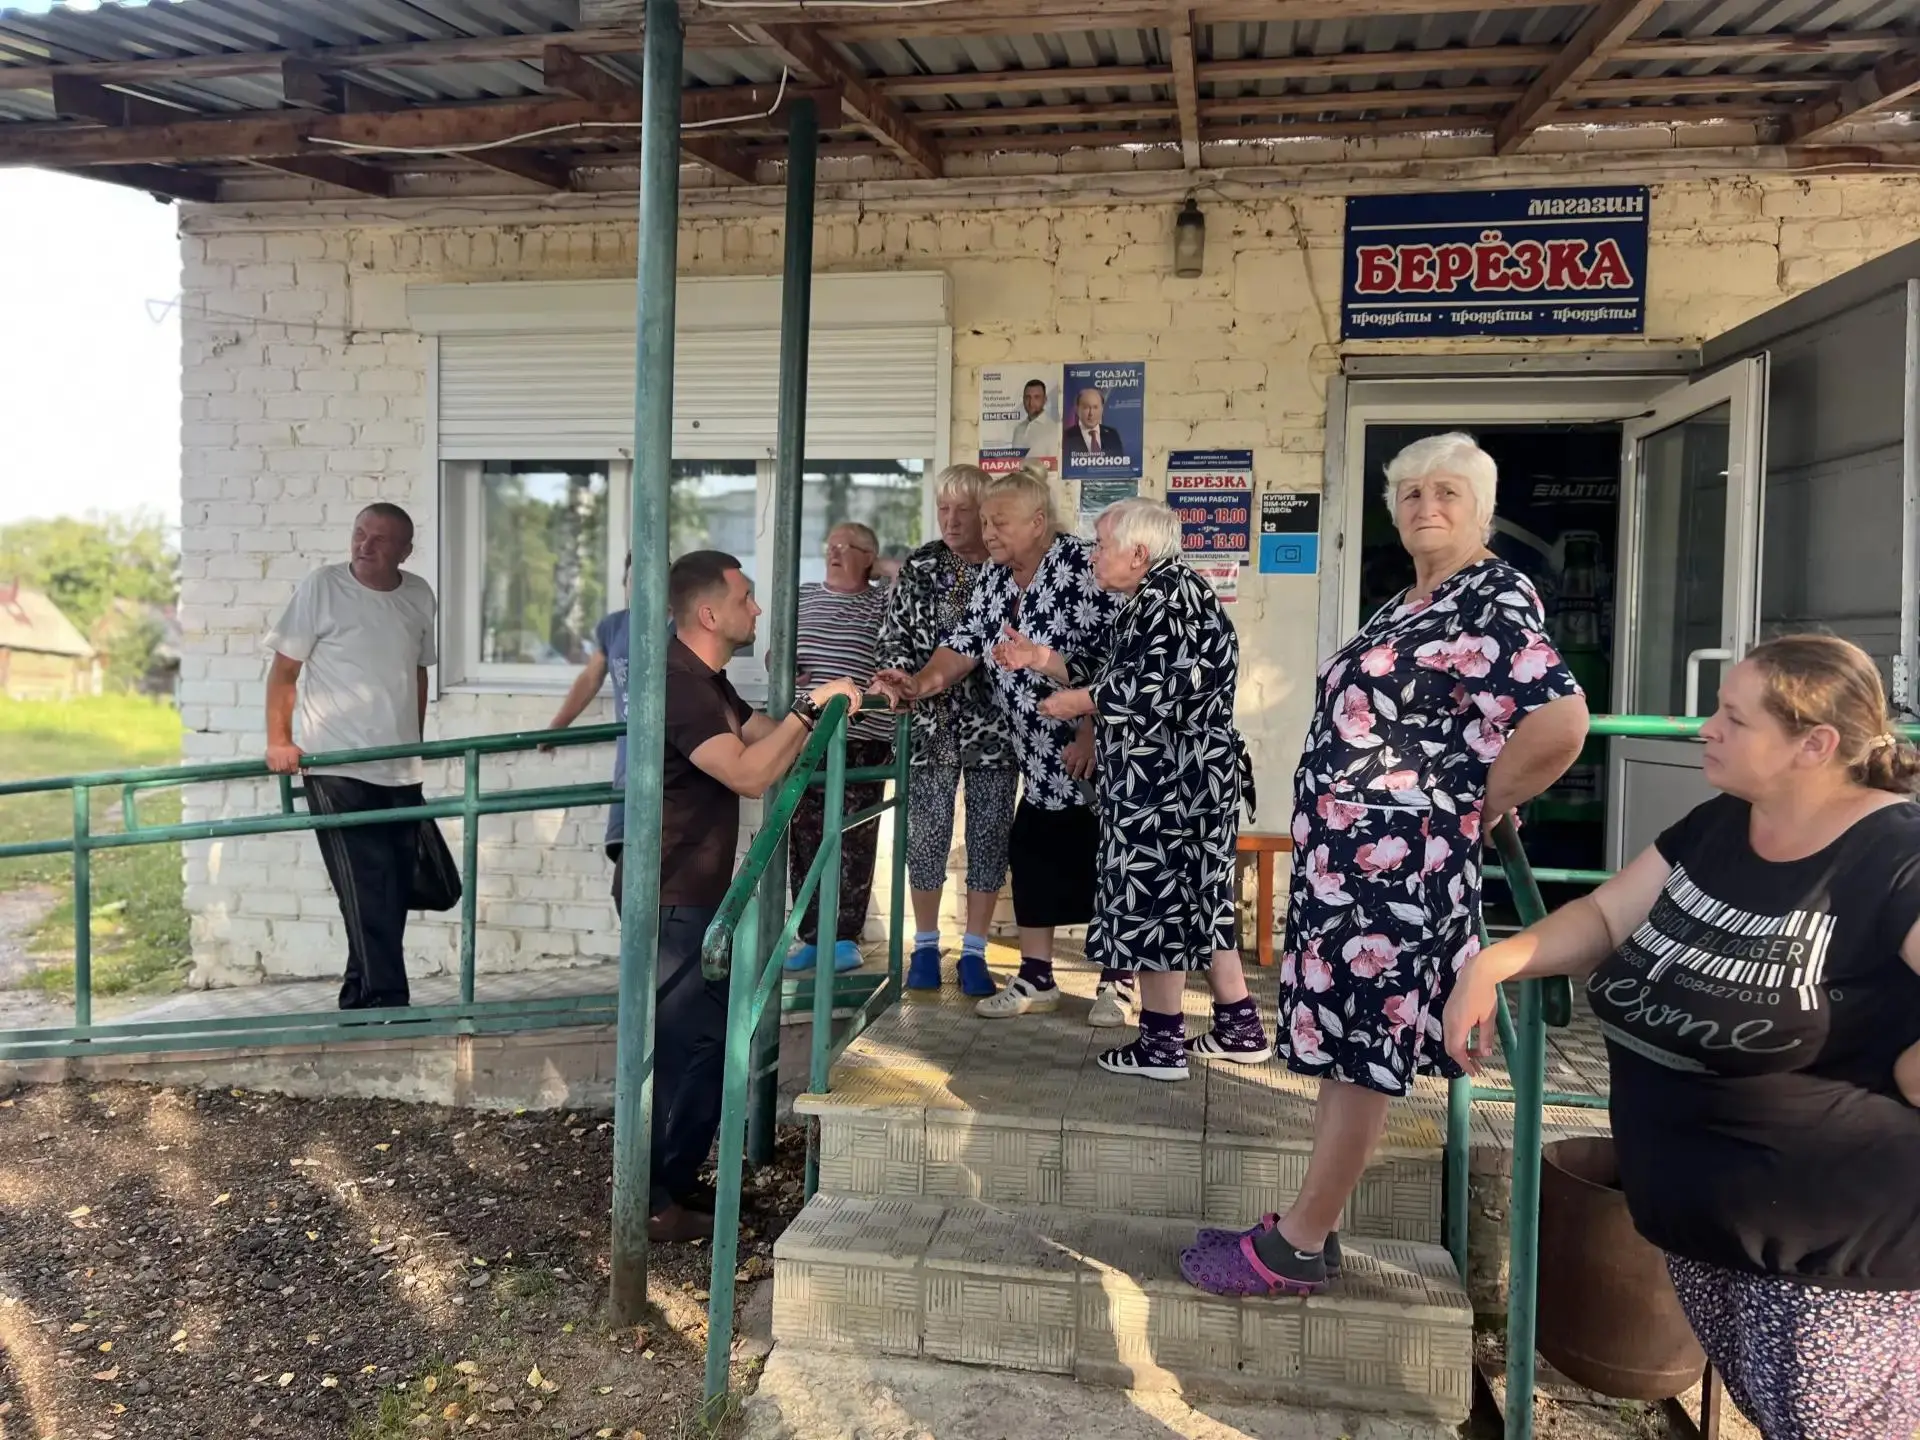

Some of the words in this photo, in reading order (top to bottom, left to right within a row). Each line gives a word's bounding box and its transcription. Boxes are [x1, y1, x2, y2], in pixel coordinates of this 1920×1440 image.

[1527, 196, 1644, 216] магазин
[1355, 230, 1634, 294] БЕРЁЗКА
[1351, 310, 1432, 326] продукты
[1451, 309, 1533, 325] продукты
[1552, 307, 1637, 323] продукты
[1094, 369, 1136, 379] СКАЗАЛ
[1094, 379, 1139, 389] СДЕЛАЛ!
[983, 412, 1020, 420] ВМЕСТЕ!
[981, 460, 1051, 470] ПАРАМВ
[1070, 456, 1131, 466] КОНОНОВ
[1179, 495, 1207, 503] РЕЖИМ
[1209, 495, 1239, 503] РАБОТЫ
[1214, 507, 1247, 524] 18.00
[1212, 533, 1246, 549] 13.30
[1695, 930, 1805, 964] BLOGGER
[1674, 973, 1780, 1005] 008427010
